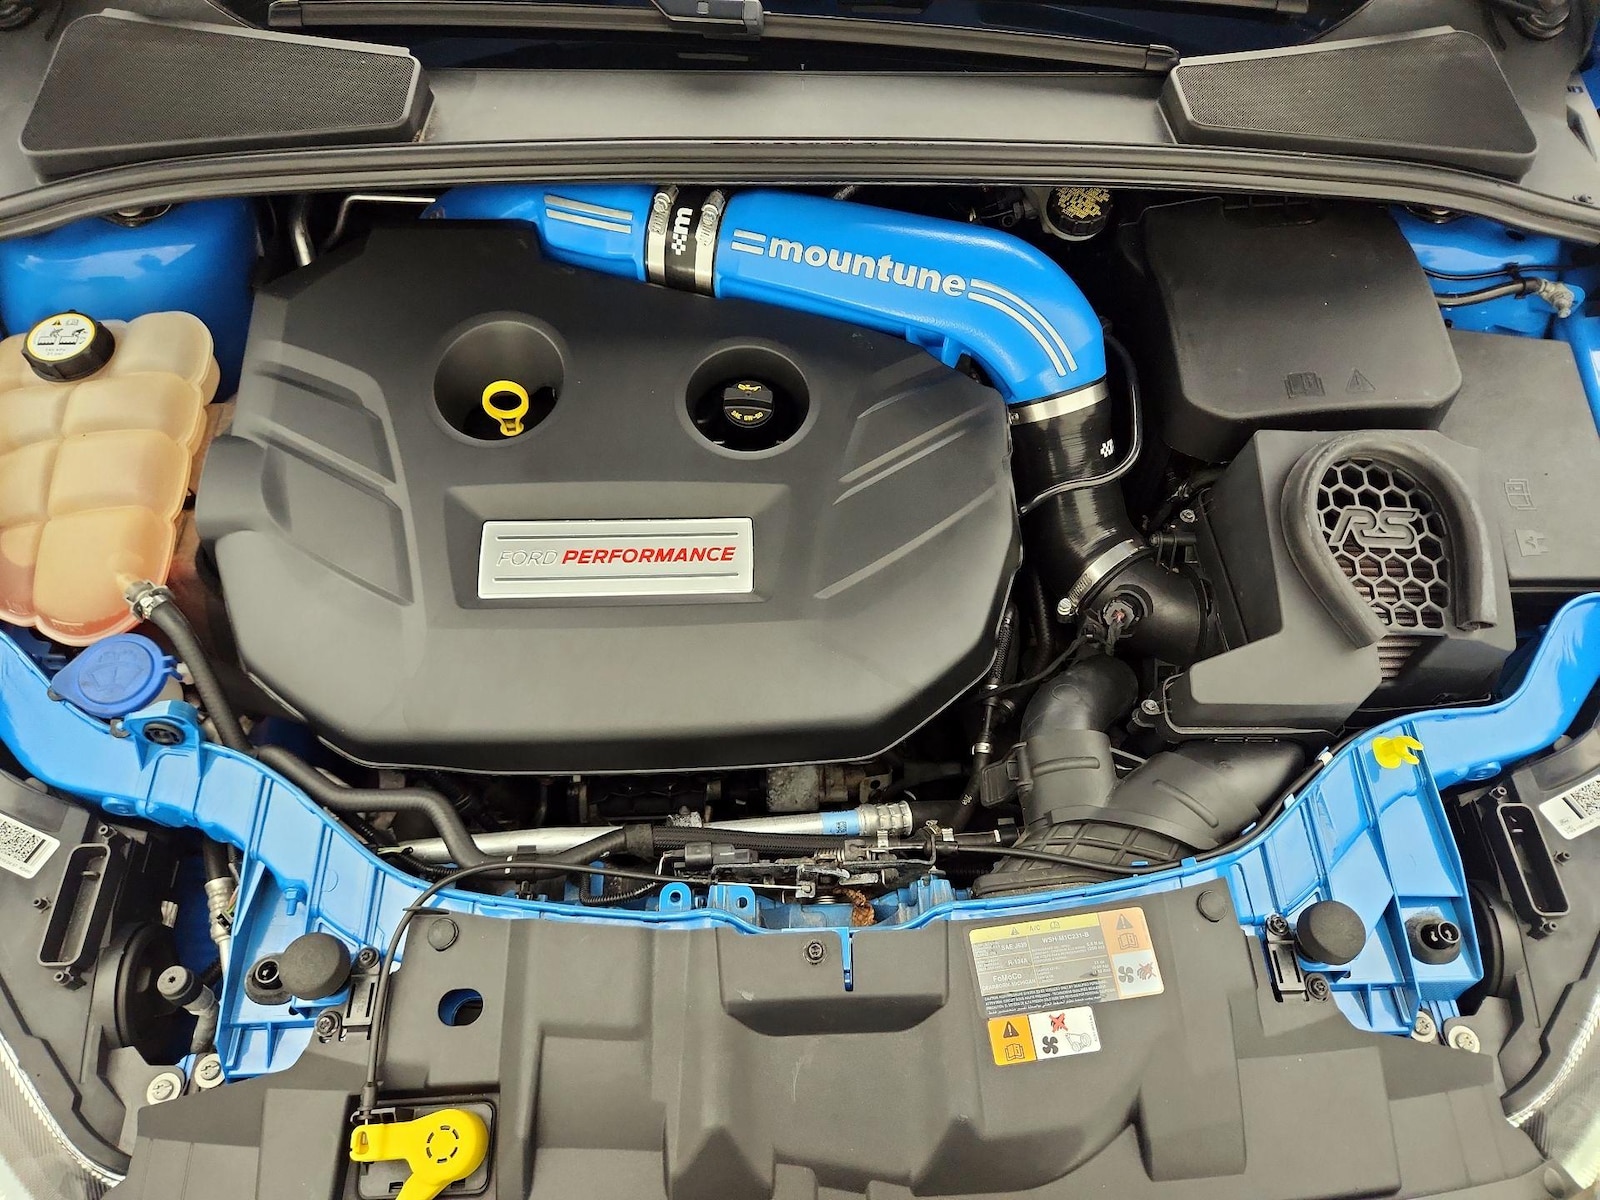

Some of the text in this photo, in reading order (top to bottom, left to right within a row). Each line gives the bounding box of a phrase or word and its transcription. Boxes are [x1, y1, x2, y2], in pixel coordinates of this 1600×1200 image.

[768, 236, 966, 296] mountune
[731, 410, 742, 420] SAE
[1328, 505, 1420, 549] RS
[497, 546, 736, 566] FORD PERFORMANCE
[1001, 943, 1013, 951] SAE
[993, 972, 1022, 981] FoMoCo
